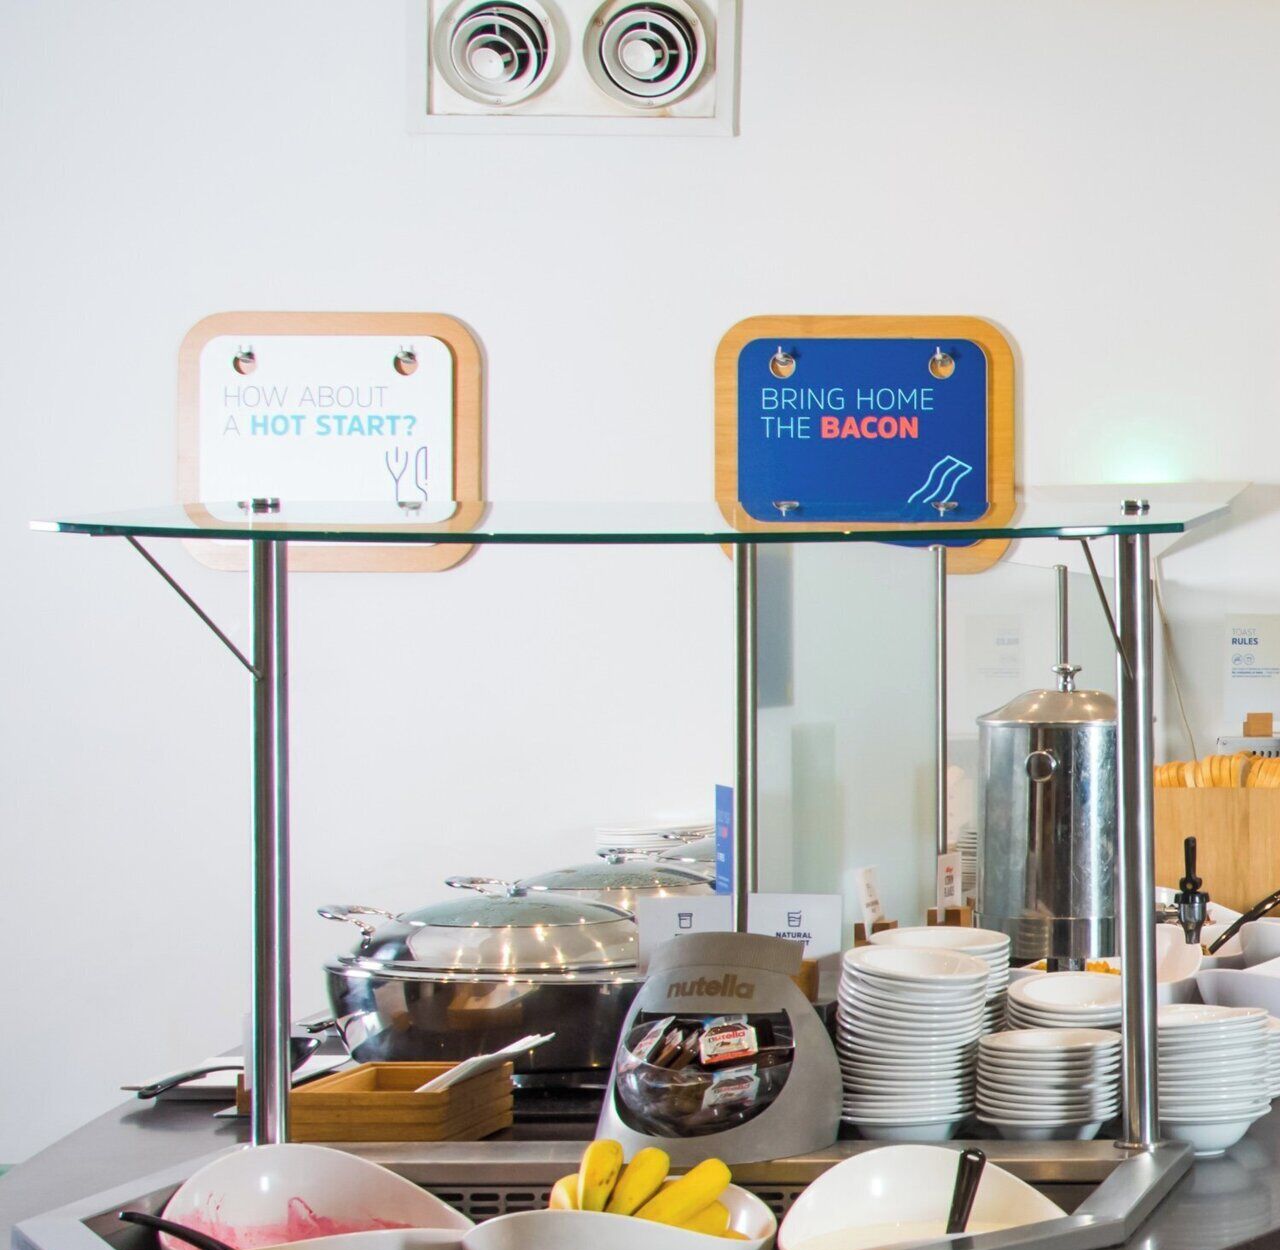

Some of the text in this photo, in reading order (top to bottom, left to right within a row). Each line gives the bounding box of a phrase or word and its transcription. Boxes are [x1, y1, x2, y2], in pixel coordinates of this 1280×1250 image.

[223, 385, 389, 408] HOW ABOUT
[761, 387, 934, 411] BRING HOME
[223, 414, 417, 436] A HOT START?
[760, 415, 919, 439] THE BACON
[1231, 628, 1257, 637] TOAST
[1231, 637, 1259, 646] RULES
[776, 931, 813, 939] NATURAL
[666, 973, 756, 999] nutella
[708, 1030, 746, 1043] nutella
